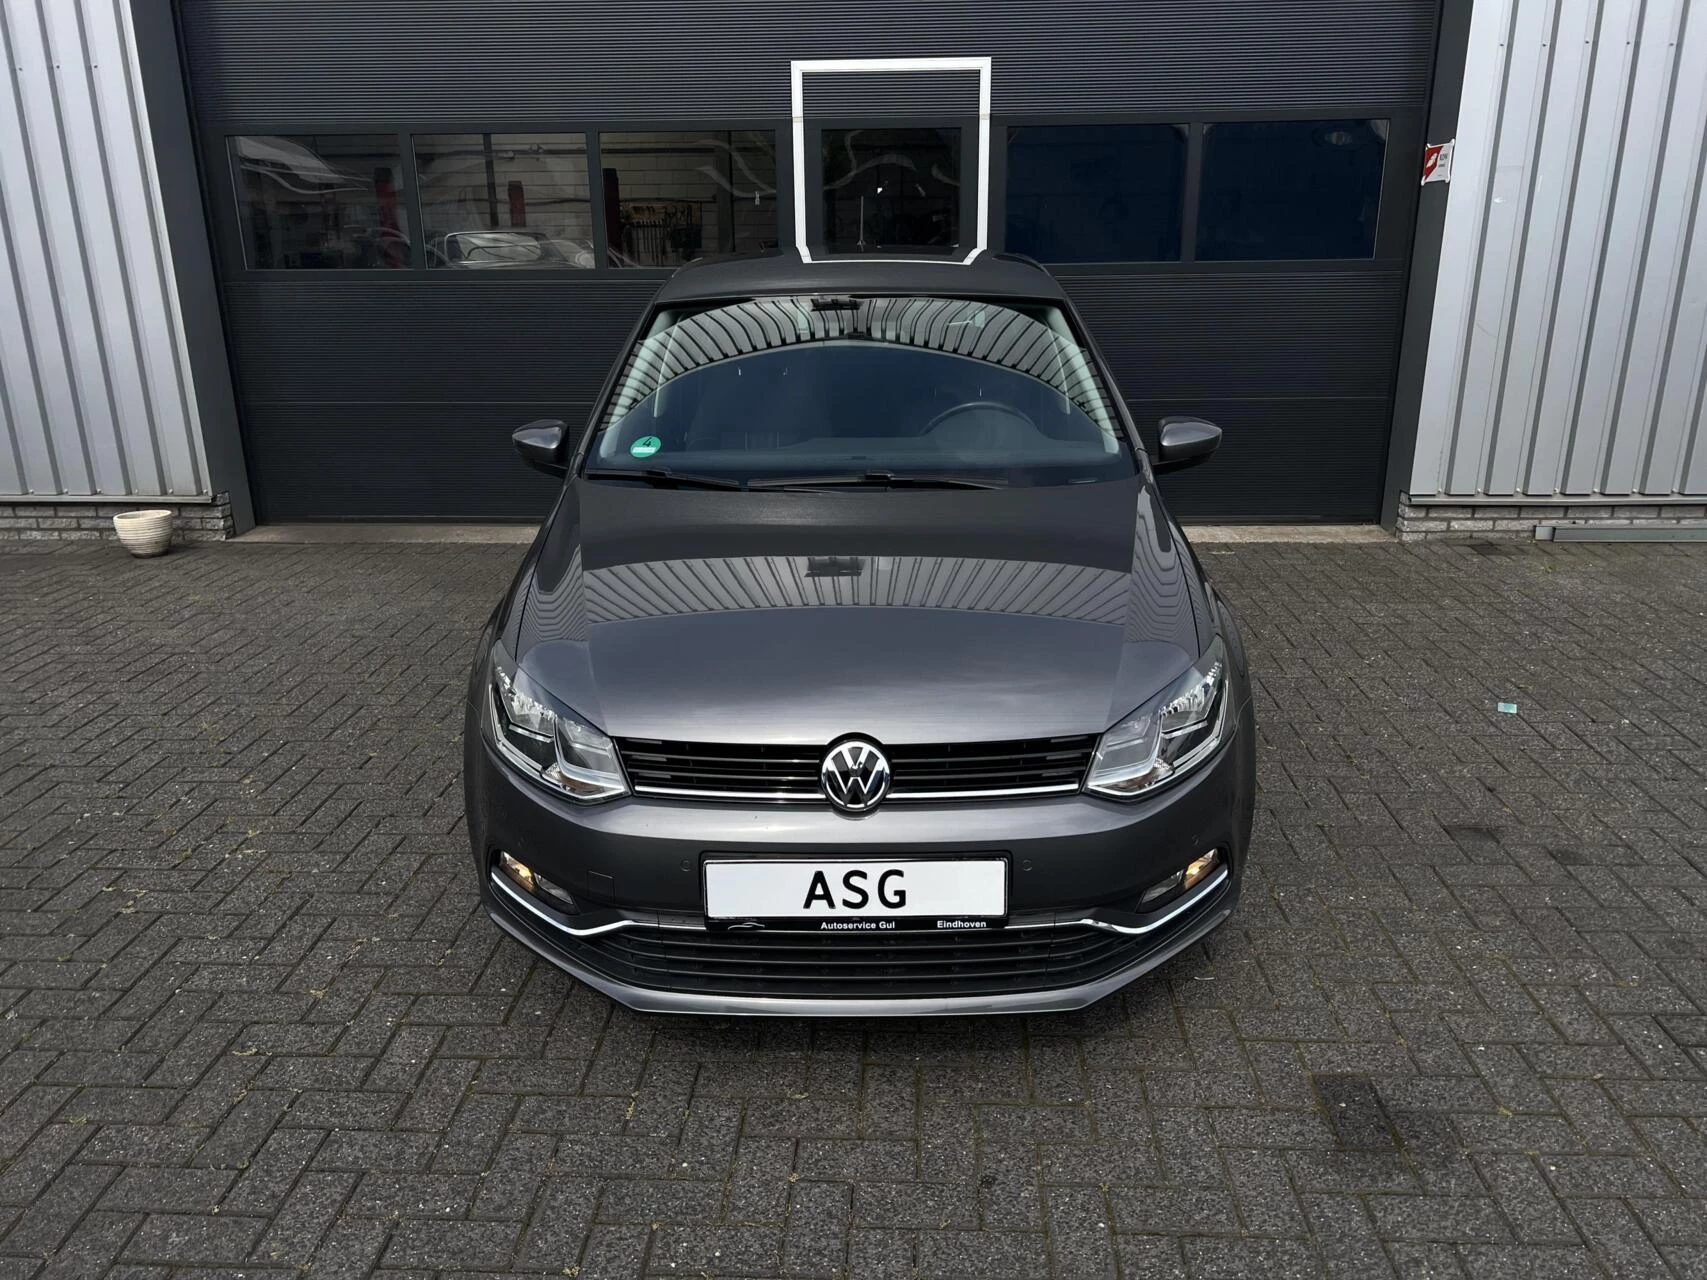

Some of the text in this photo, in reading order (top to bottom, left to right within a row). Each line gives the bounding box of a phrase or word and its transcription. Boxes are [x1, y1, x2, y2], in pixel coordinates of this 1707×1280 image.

[642, 436, 652, 447] 4
[822, 741, 890, 809] VW
[803, 869, 906, 909] ASG
[820, 921, 877, 930] Autoservice
[937, 920, 987, 929] Eindhoven
